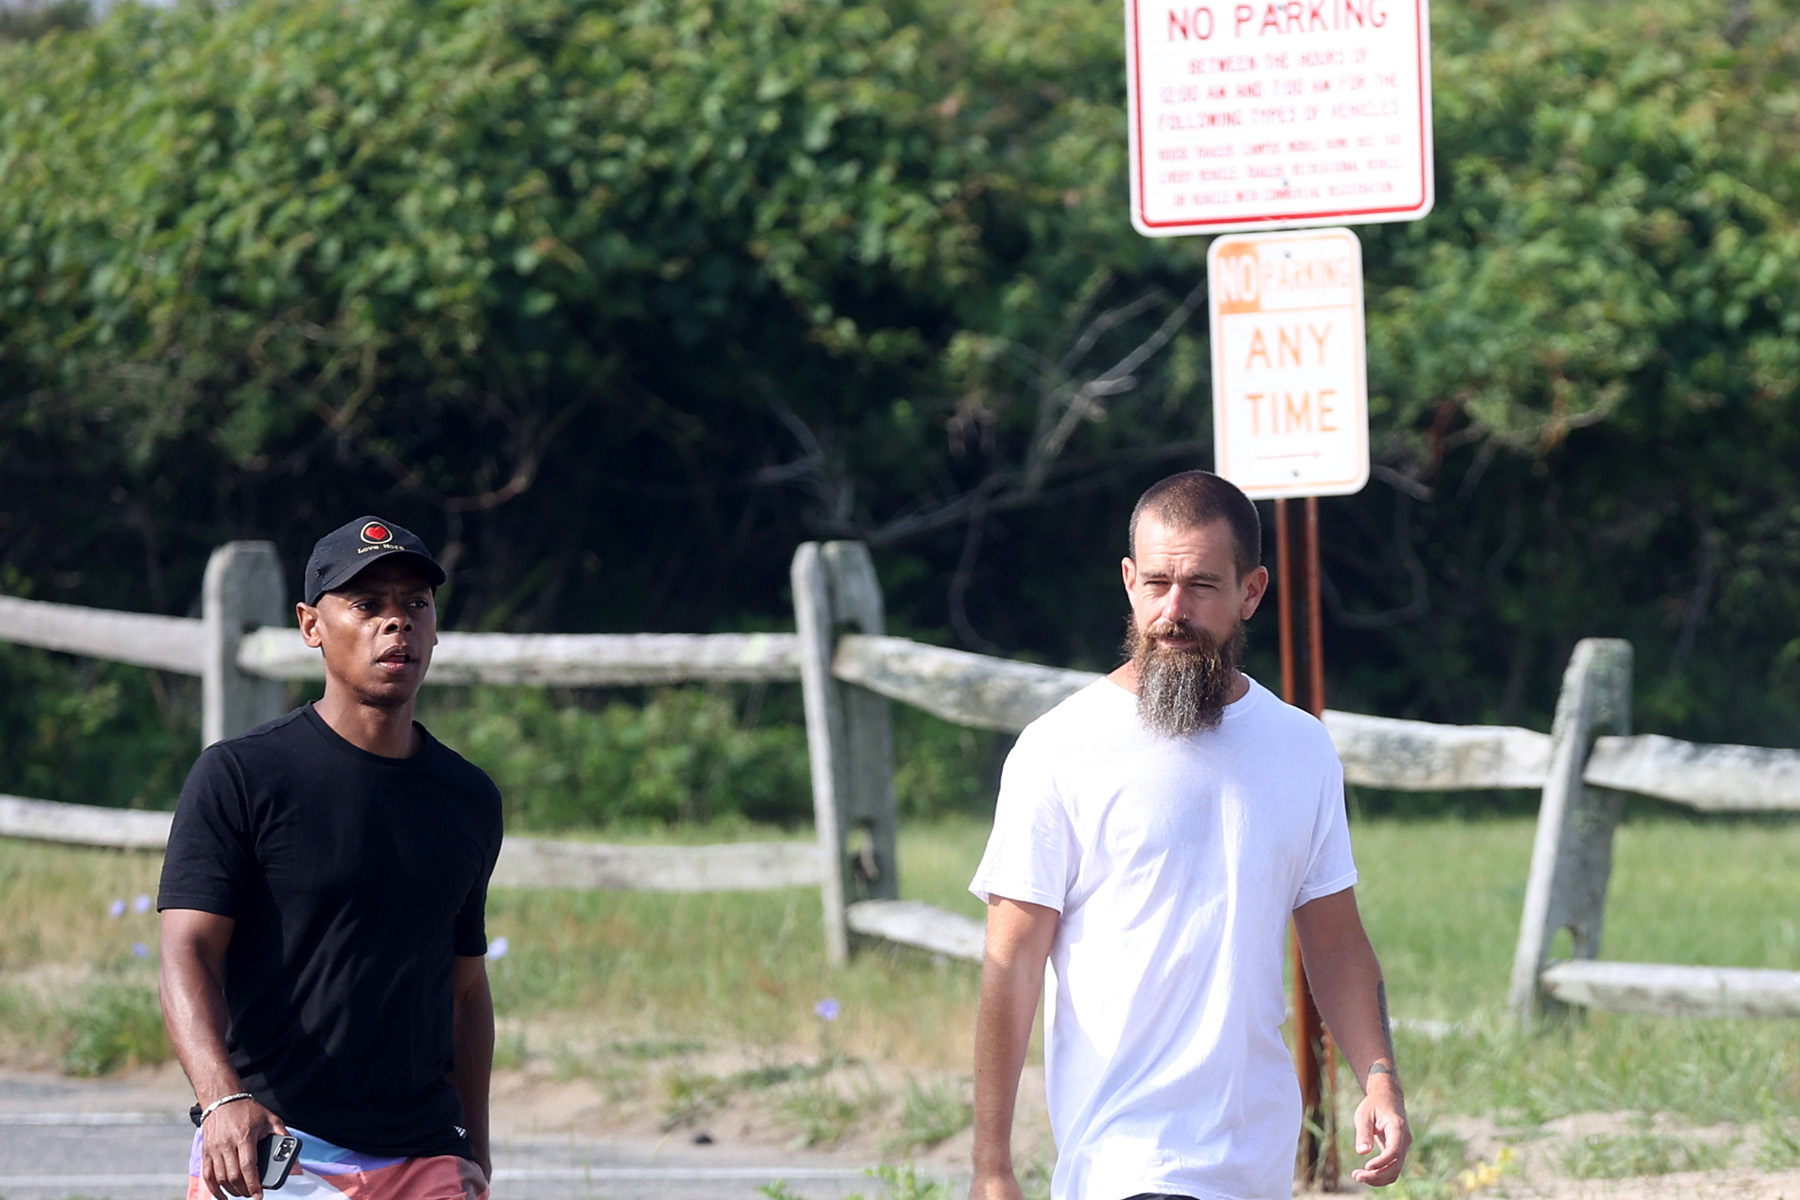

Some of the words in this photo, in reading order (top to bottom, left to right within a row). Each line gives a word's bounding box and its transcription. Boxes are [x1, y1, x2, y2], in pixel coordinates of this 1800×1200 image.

[1168, 6, 1214, 41] NO
[1234, 0, 1387, 37] PARKING
[1188, 55, 1257, 75] BETWEEN
[1266, 52, 1289, 69] THE
[1299, 49, 1343, 67] HOURS
[1208, 85, 1227, 100] AM
[1236, 81, 1262, 98] AND
[1312, 79, 1331, 93] AM
[1377, 73, 1397, 88] THE
[1158, 110, 1242, 130] FOLLOWING
[1218, 253, 1258, 303] NO
[1262, 257, 1348, 292] PARKING
[1245, 322, 1333, 370] ANY
[1244, 388, 1338, 436] TIME
[357, 545, 379, 554] Love
